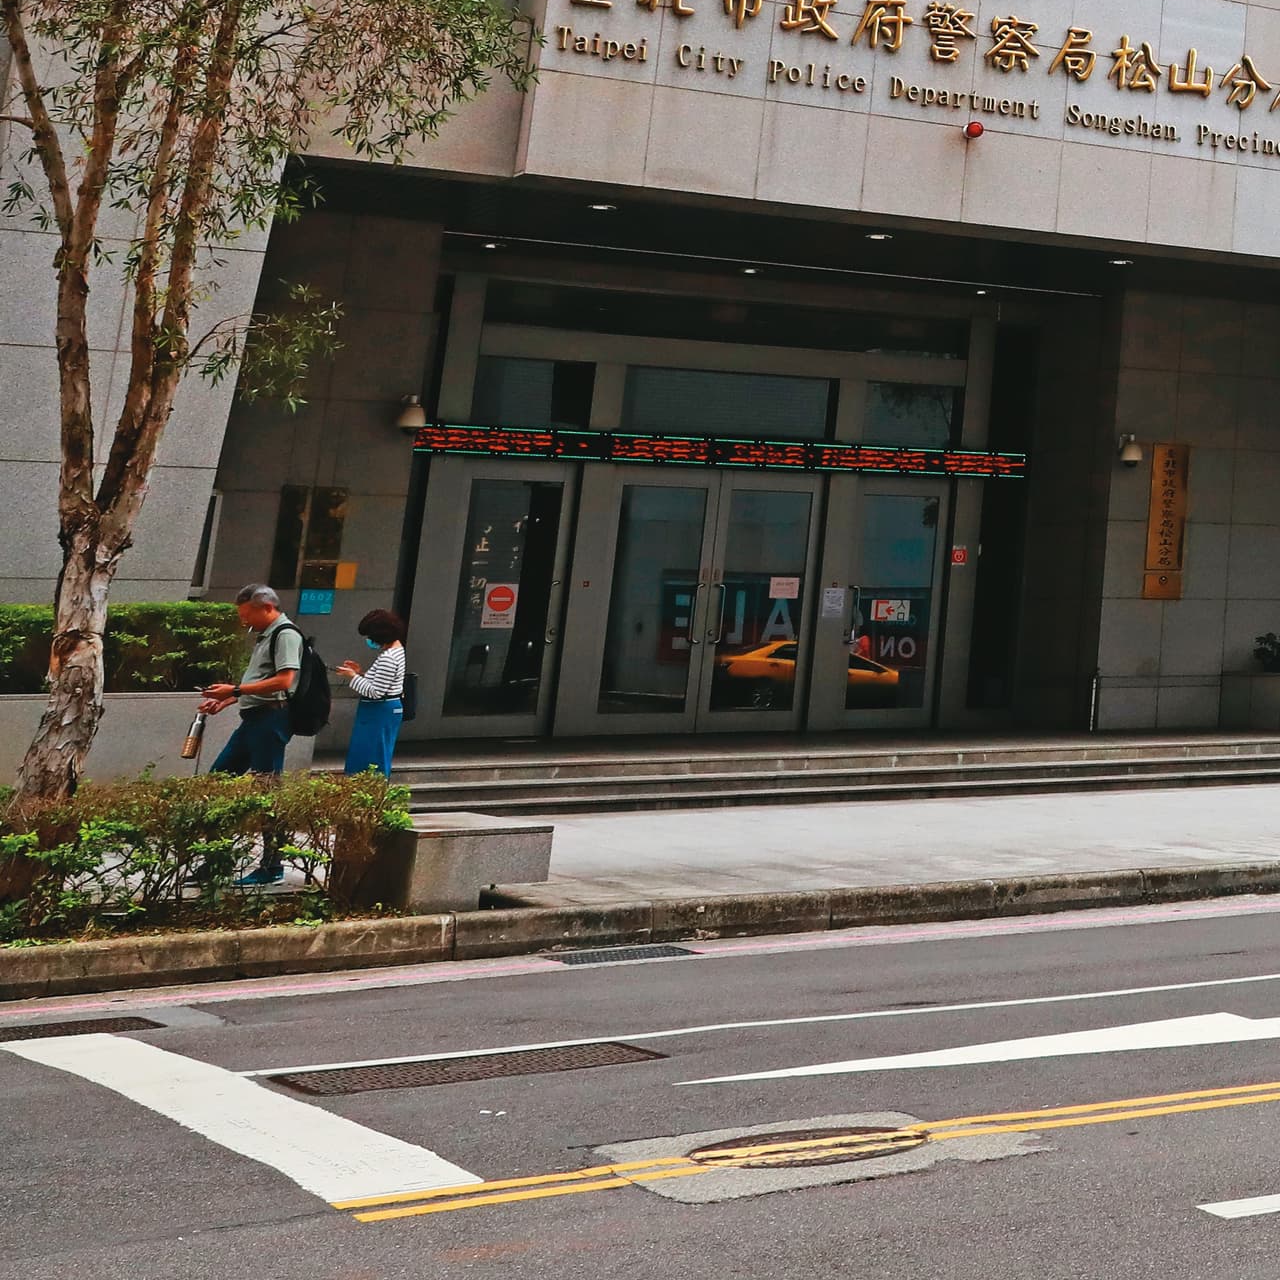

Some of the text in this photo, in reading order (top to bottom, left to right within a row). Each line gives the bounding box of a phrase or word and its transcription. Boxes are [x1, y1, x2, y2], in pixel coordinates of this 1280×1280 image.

[556, 25, 648, 62] Taipei
[677, 44, 744, 77] City
[769, 59, 867, 93] Police
[890, 76, 1040, 119] Department
[1065, 104, 1178, 140] Songshan
